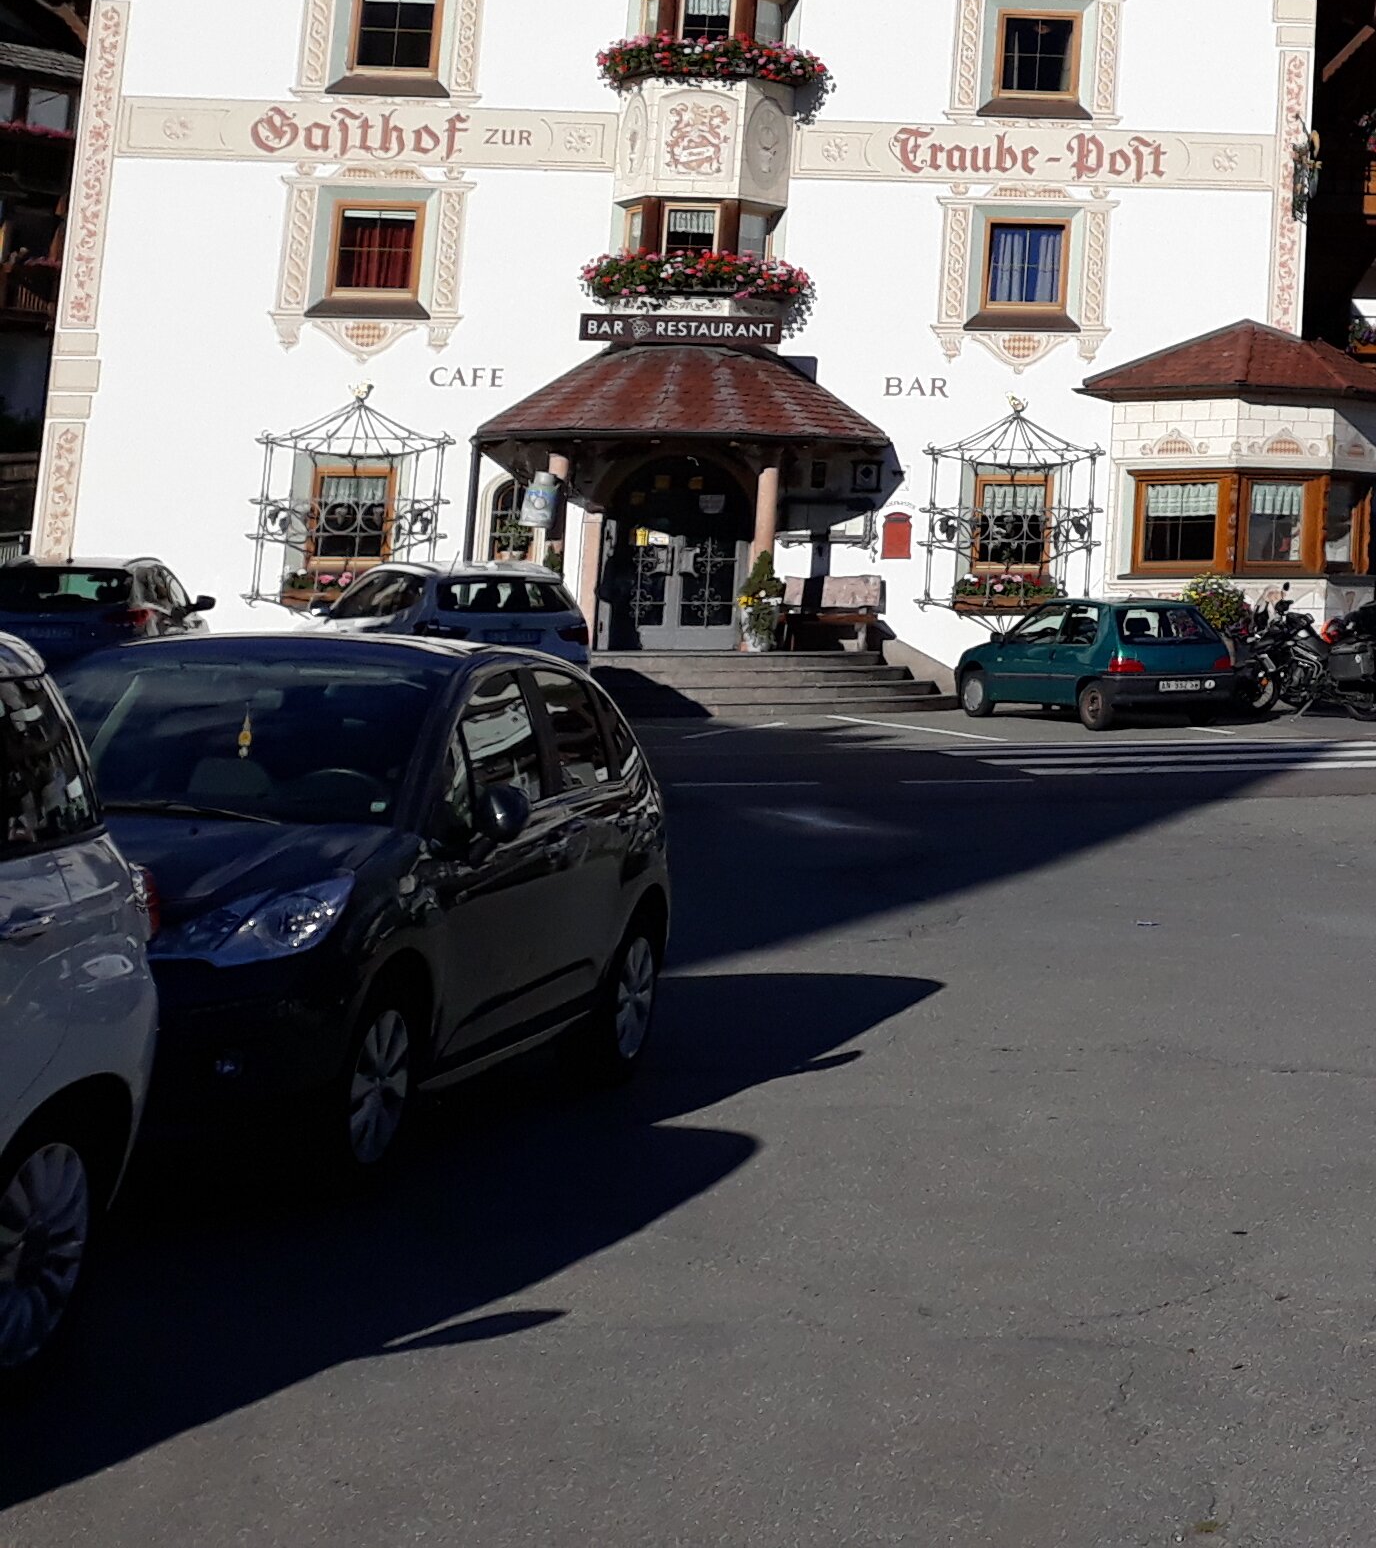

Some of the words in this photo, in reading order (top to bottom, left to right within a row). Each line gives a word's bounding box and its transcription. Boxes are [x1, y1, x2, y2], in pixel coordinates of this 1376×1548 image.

[586, 319, 624, 336] BAR
[655, 321, 775, 339] RESTAURANT
[429, 366, 504, 388] CAFE
[882, 376, 949, 399] BAR
